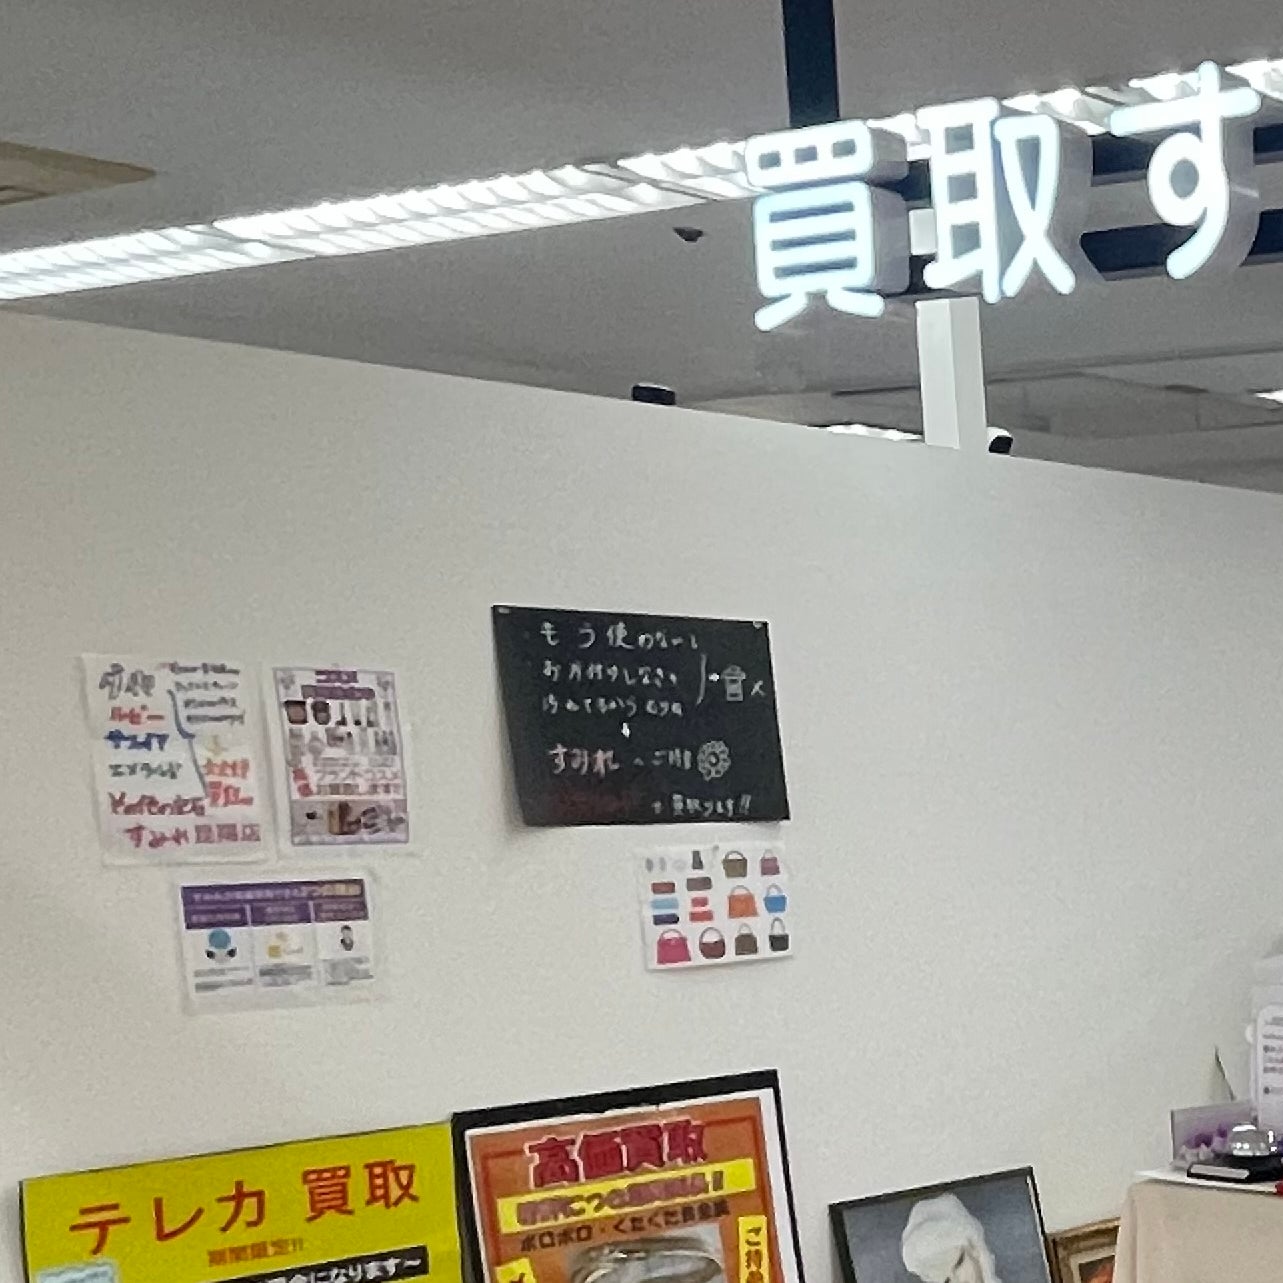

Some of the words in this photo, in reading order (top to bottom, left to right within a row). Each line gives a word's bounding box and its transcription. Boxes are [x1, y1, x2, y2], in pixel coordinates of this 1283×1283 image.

[522, 1118, 709, 1189] 高価買取
[69, 1180, 267, 1256] テレカ
[302, 1159, 420, 1222] 買取
